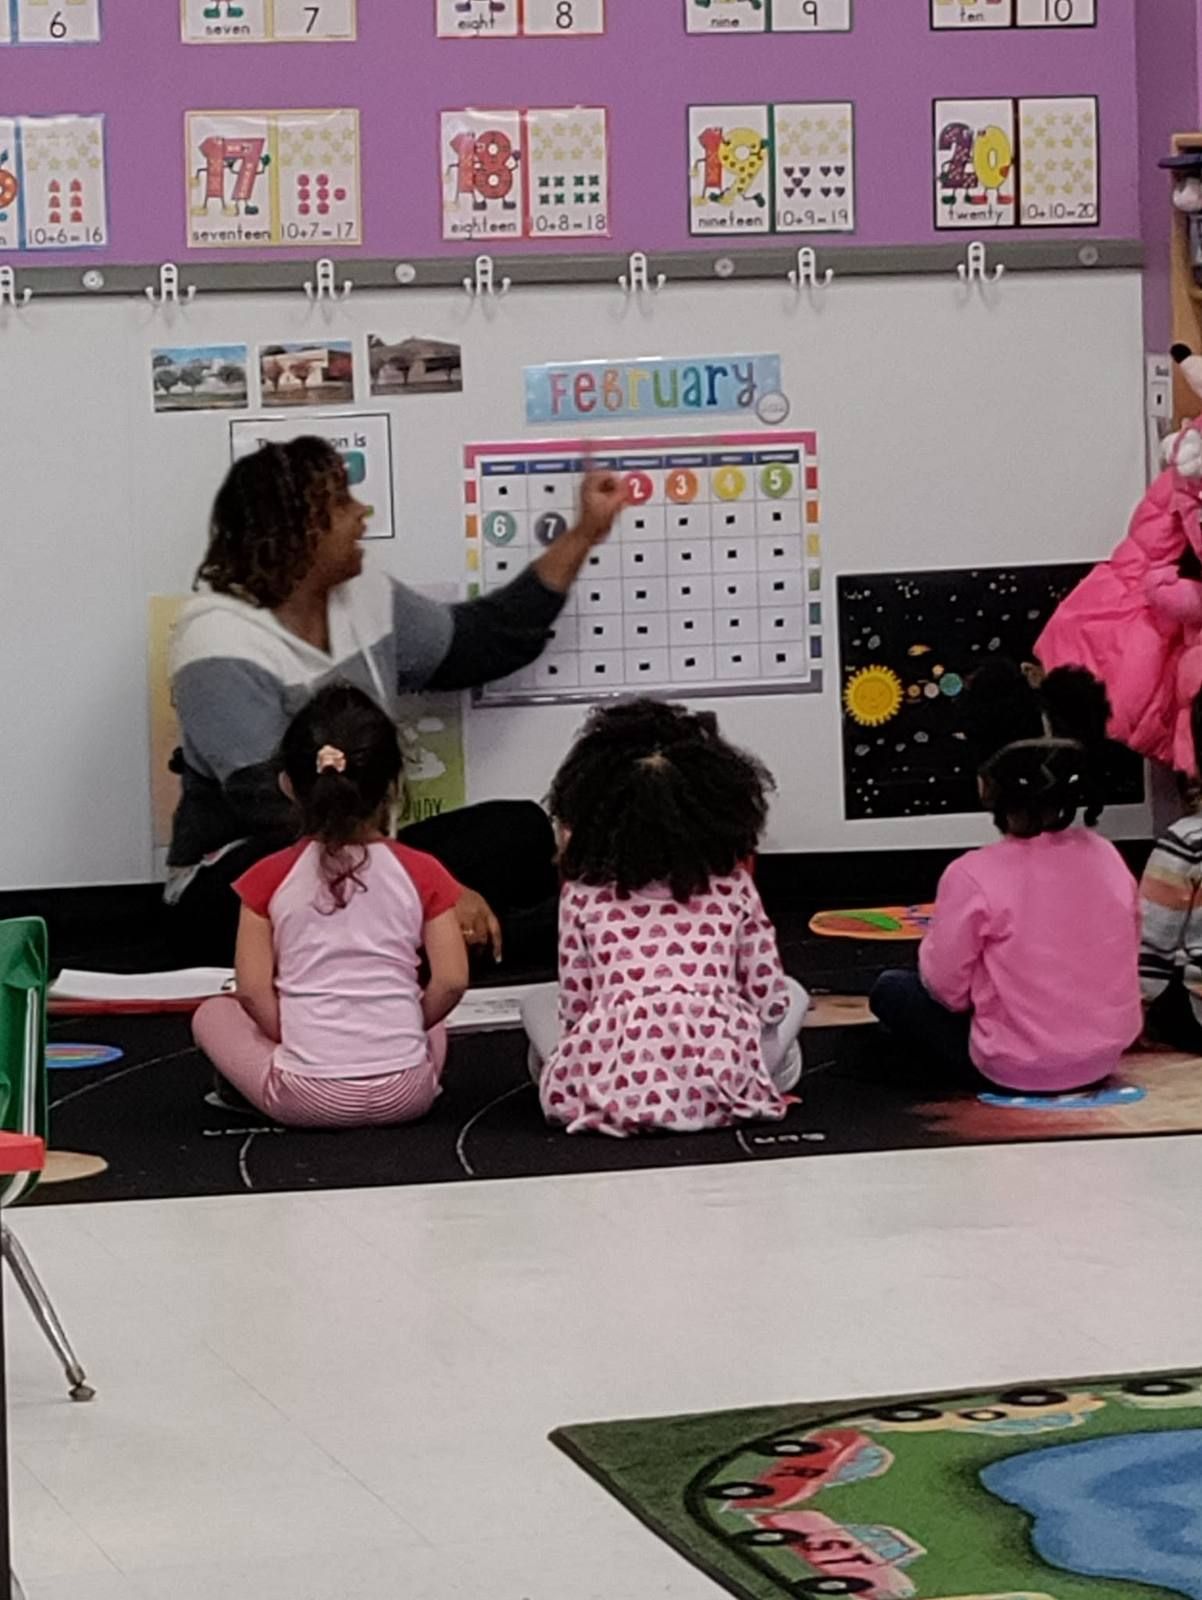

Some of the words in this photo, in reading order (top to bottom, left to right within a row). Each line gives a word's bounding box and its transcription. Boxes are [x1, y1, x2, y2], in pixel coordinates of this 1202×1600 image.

[303, 7, 320, 34] 7
[556, 1, 573, 29] 8
[711, 15, 740, 27] nine
[802, 1, 818, 26] 9
[960, 7, 984, 22] ten
[1044, 0, 1073, 22] 10
[50, 11, 67, 39] 6
[205, 25, 250, 35] seven
[458, 13, 495, 37] eight
[698, 211, 763, 227] nineteen
[948, 204, 1003, 226] twenty
[193, 225, 271, 241] seventeen
[451, 215, 517, 241] eighteen
[629, 477, 644, 498] 2
[674, 474, 687, 495] 3
[723, 472, 736, 493] 4
[770, 469, 783, 490] 5
[493, 515, 507, 537] 6
[545, 518, 558, 539] 7
